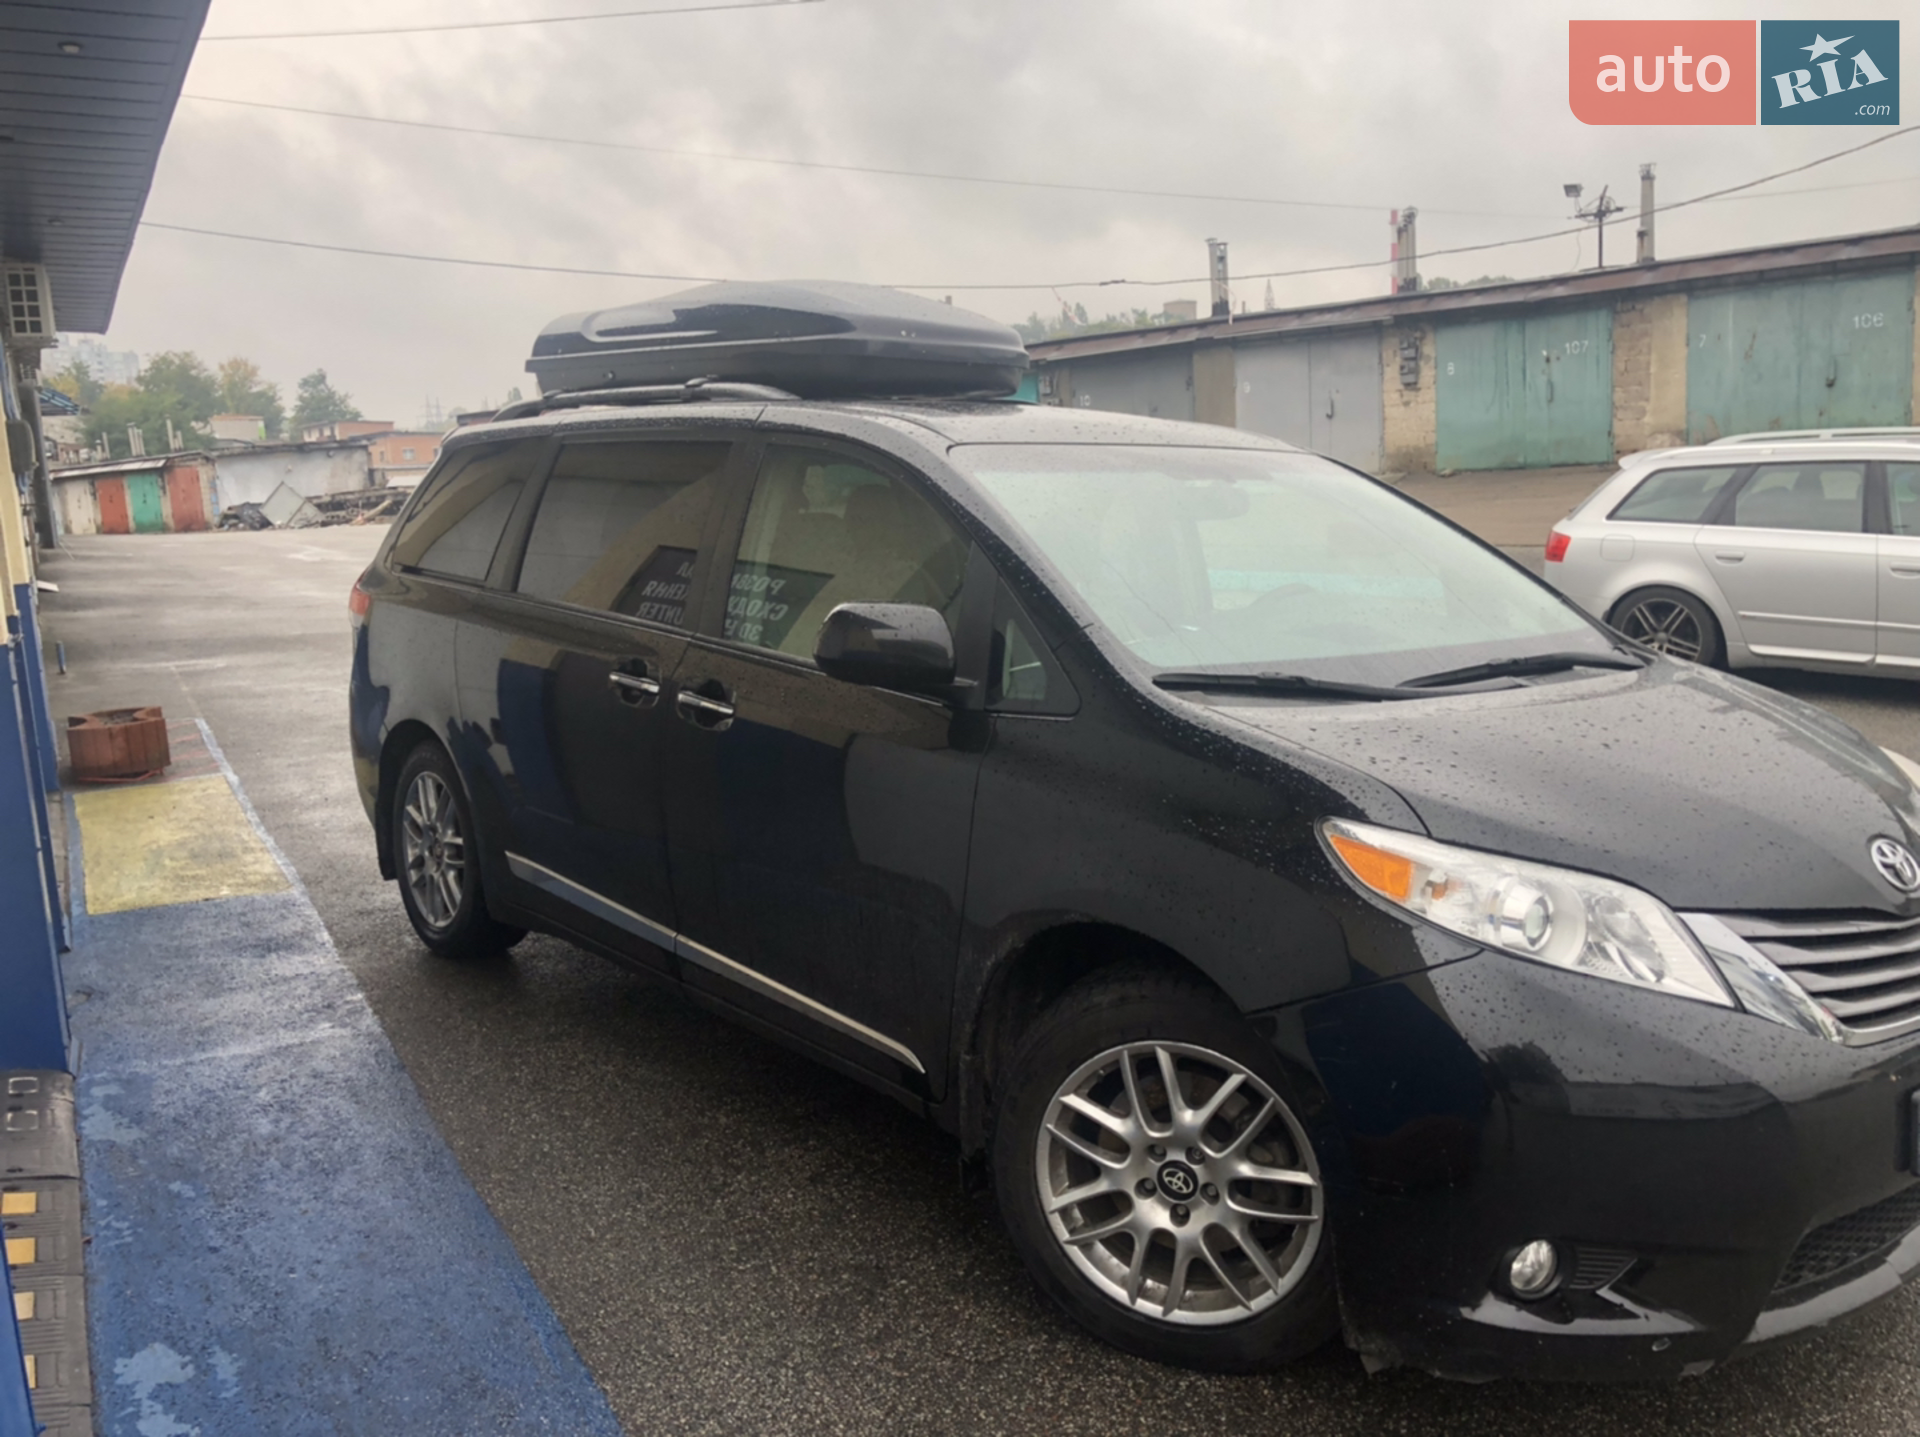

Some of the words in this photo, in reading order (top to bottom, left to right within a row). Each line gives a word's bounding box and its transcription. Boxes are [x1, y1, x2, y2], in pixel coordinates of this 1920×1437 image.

[1853, 312, 1884, 329] 106
[1565, 340, 1589, 355] 107
[1080, 395, 1091, 407] 10
